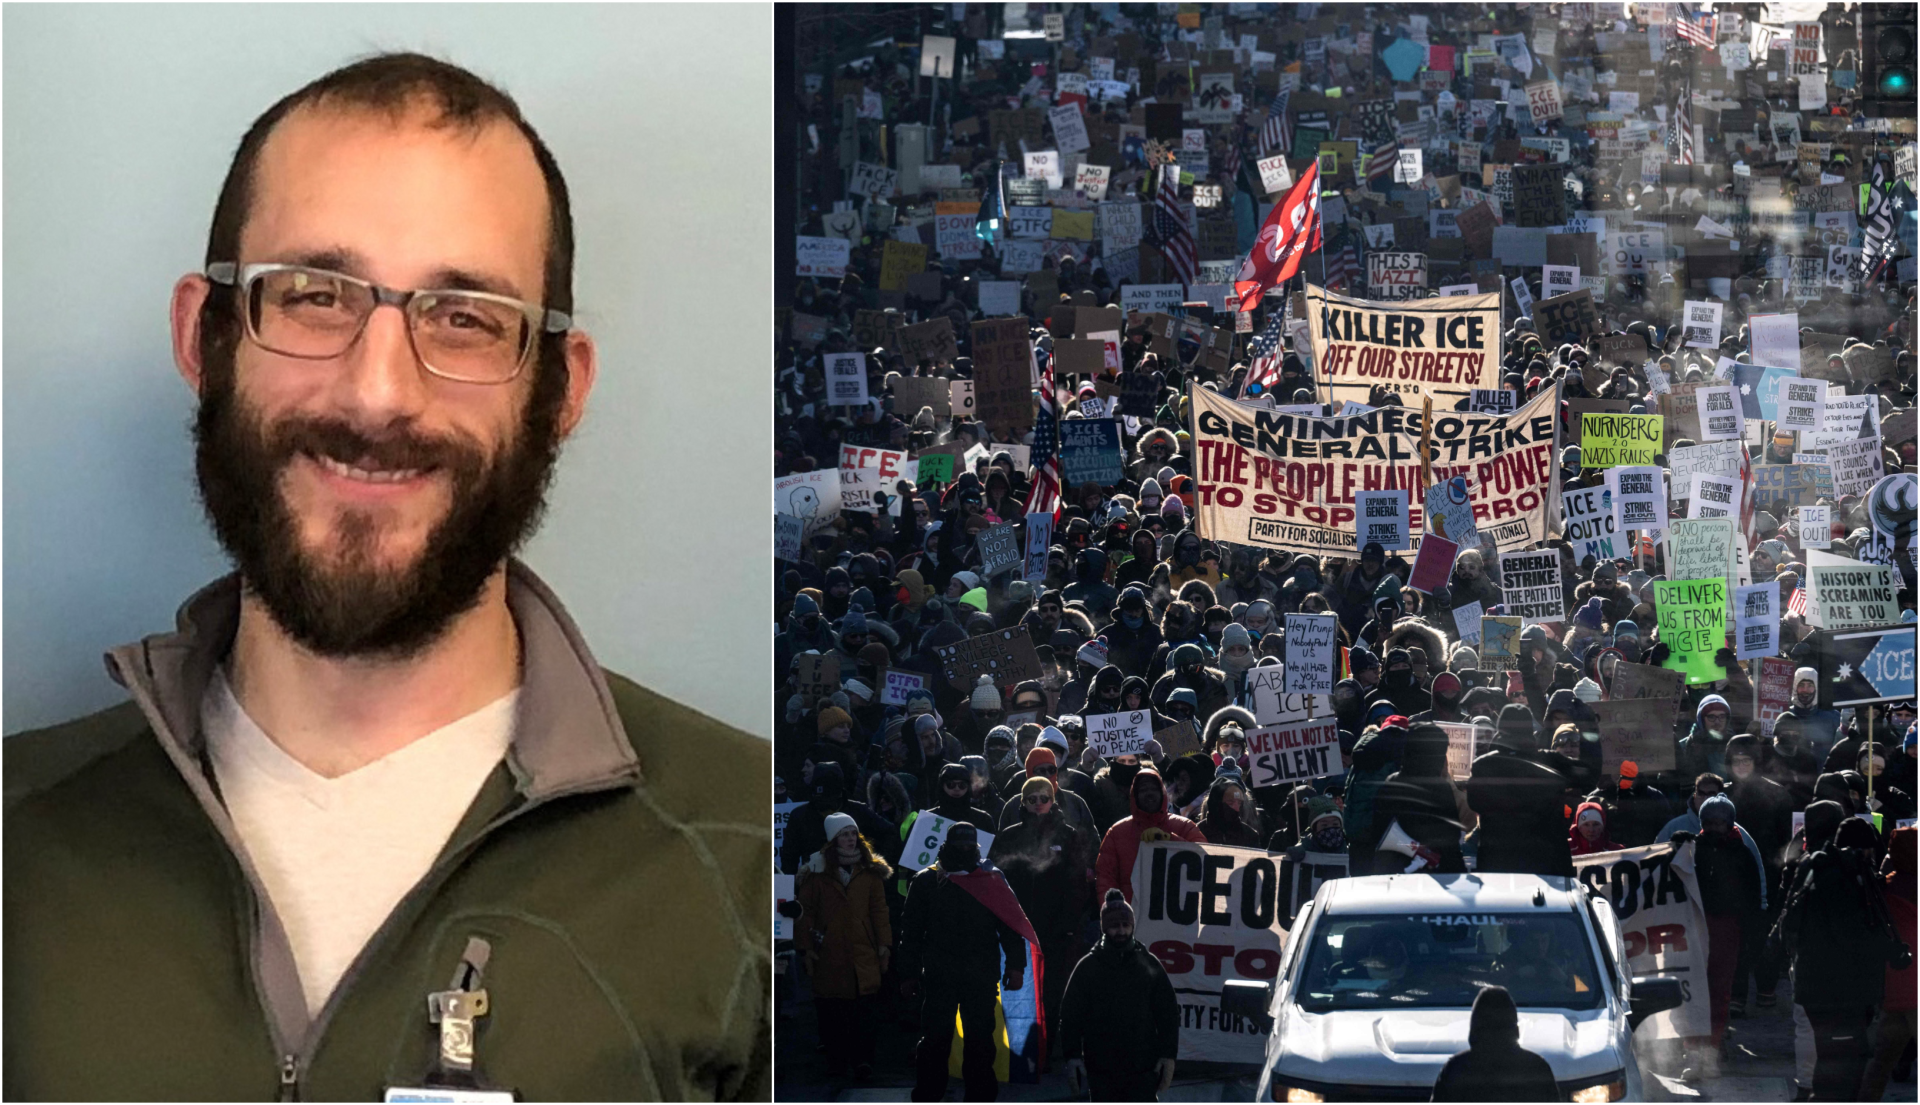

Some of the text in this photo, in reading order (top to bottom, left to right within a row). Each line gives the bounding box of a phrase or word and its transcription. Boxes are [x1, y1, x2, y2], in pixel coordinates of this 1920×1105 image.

[1795, 24, 1820, 39] NO
[1795, 39, 1819, 48] KINGS
[1725, 47, 1745, 60] ICE
[1794, 49, 1818, 64] NO
[1529, 88, 1555, 104] ICE
[1532, 103, 1558, 118] OUT!
[1595, 129, 1616, 137] MSP
[1031, 155, 1049, 165] NO
[1258, 156, 1284, 173] FUCK
[1085, 168, 1103, 177] NO
[1514, 167, 1562, 185] WHAT
[860, 180, 889, 196] ICE
[1083, 184, 1099, 193] NO
[1020, 208, 1045, 217] ICE
[1108, 214, 1137, 226] CHILD
[1520, 209, 1567, 227] FUCK
[1617, 233, 1650, 248] ICE
[1814, 228, 1847, 246] ICE
[1370, 254, 1411, 270] THIS
[1615, 250, 1658, 270] OUT
[1372, 270, 1420, 285] NAZI
[1550, 277, 1573, 286] GENERAL
[1155, 289, 1182, 298] THEN
[1125, 301, 1148, 311] THEY
[1540, 296, 1594, 325] ICE
[857, 312, 901, 328] ICE
[1321, 307, 1484, 349] KILLER ICE
[1549, 315, 1596, 342] OUT
[1603, 339, 1636, 351] FUCK
[1321, 344, 1485, 385] OFF OUR STREETS!
[1851, 350, 1882, 370] FUCK
[1671, 384, 1696, 396] ICE
[1789, 384, 1818, 394] EXPAND THE
[1476, 390, 1512, 405] KILLER
[1707, 392, 1731, 402] JUSTICE
[1788, 391, 1817, 403] GENERAL
[1707, 401, 1734, 412] FOR ALEX
[1788, 406, 1814, 417] STRIKE!
[1074, 424, 1102, 435] ICE
[1255, 409, 1508, 439] MINNESOTA
[1064, 433, 1108, 446] AGENTS
[1198, 411, 1411, 460] GENERAL
[1417, 415, 1553, 462] STRIKE
[1074, 446, 1100, 457] ARE
[1675, 441, 1736, 461] SILENCE
[1859, 440, 1878, 453] WHAT
[920, 457, 944, 467] FUCK
[1064, 453, 1122, 469] EXECUTING
[1583, 447, 1616, 465] NAZIS
[1809, 455, 1827, 464] ICE
[1842, 455, 1868, 469] SOUNDS
[842, 446, 902, 482] ICE
[1670, 457, 1740, 478] NEUTRALITY
[919, 468, 942, 480] ICE
[1198, 440, 1357, 504] THE PEOPLE
[1620, 473, 1653, 483] EXPAND THE
[1755, 466, 1801, 487] ICE
[1841, 467, 1874, 482] LIKE WHEN
[775, 474, 823, 491] ABOLISH ICE
[1621, 482, 1653, 495] GENERAL
[1701, 480, 1720, 491] EXPAND
[1721, 484, 1733, 494] THE
[1839, 481, 1862, 496] DOVES
[1366, 498, 1399, 506] EXPAND THE
[1565, 492, 1598, 518] ICE
[1700, 490, 1731, 505] GENERAL
[1198, 485, 1355, 527] TO STOP
[1366, 506, 1399, 518] GENERAL
[1625, 501, 1653, 513] STRIKE!
[1700, 506, 1728, 518] STRIKE!
[1803, 509, 1825, 523] ICE
[980, 526, 1011, 542] WE ARE
[1034, 524, 1044, 546] DO
[1255, 522, 1357, 547] PARTY FOR SOCIALISM
[1368, 523, 1398, 535] STRIKE!
[1570, 516, 1604, 540] OUT
[1681, 522, 1730, 537] NO person
[984, 537, 1009, 556] NOT
[1586, 537, 1615, 560] MN
[1680, 536, 1704, 547] shall
[1677, 543, 1711, 558] deprived
[1859, 542, 1892, 564] FUCK
[984, 549, 1019, 571] AFRAID
[1503, 556, 1558, 573] GENERAL
[1504, 571, 1560, 588] STRIKE:
[1820, 570, 1891, 586] HISTORY IS
[1505, 586, 1561, 605] THE PATH TO
[1660, 583, 1724, 606] DELIVER
[1745, 591, 1769, 605] JUSTICE
[1820, 588, 1892, 604] SCREAMING
[1506, 602, 1562, 619] JUSTICE
[1661, 606, 1723, 630] US FROM
[1744, 605, 1755, 619] FOR
[1829, 604, 1886, 620] ARE YOU
[1287, 618, 1333, 639] Hey Trump
[1668, 629, 1713, 654] ICE
[1875, 649, 1915, 682] ICE
[887, 673, 921, 688] GTFO
[1311, 680, 1331, 690] FREE
[1103, 717, 1117, 729] NO
[1092, 729, 1139, 744] JUSTICE
[1248, 724, 1339, 755] WE WILL NOT BE
[1111, 740, 1145, 755] PEACE
[1256, 746, 1330, 785] SILENT
[1148, 847, 1234, 927] ICE
